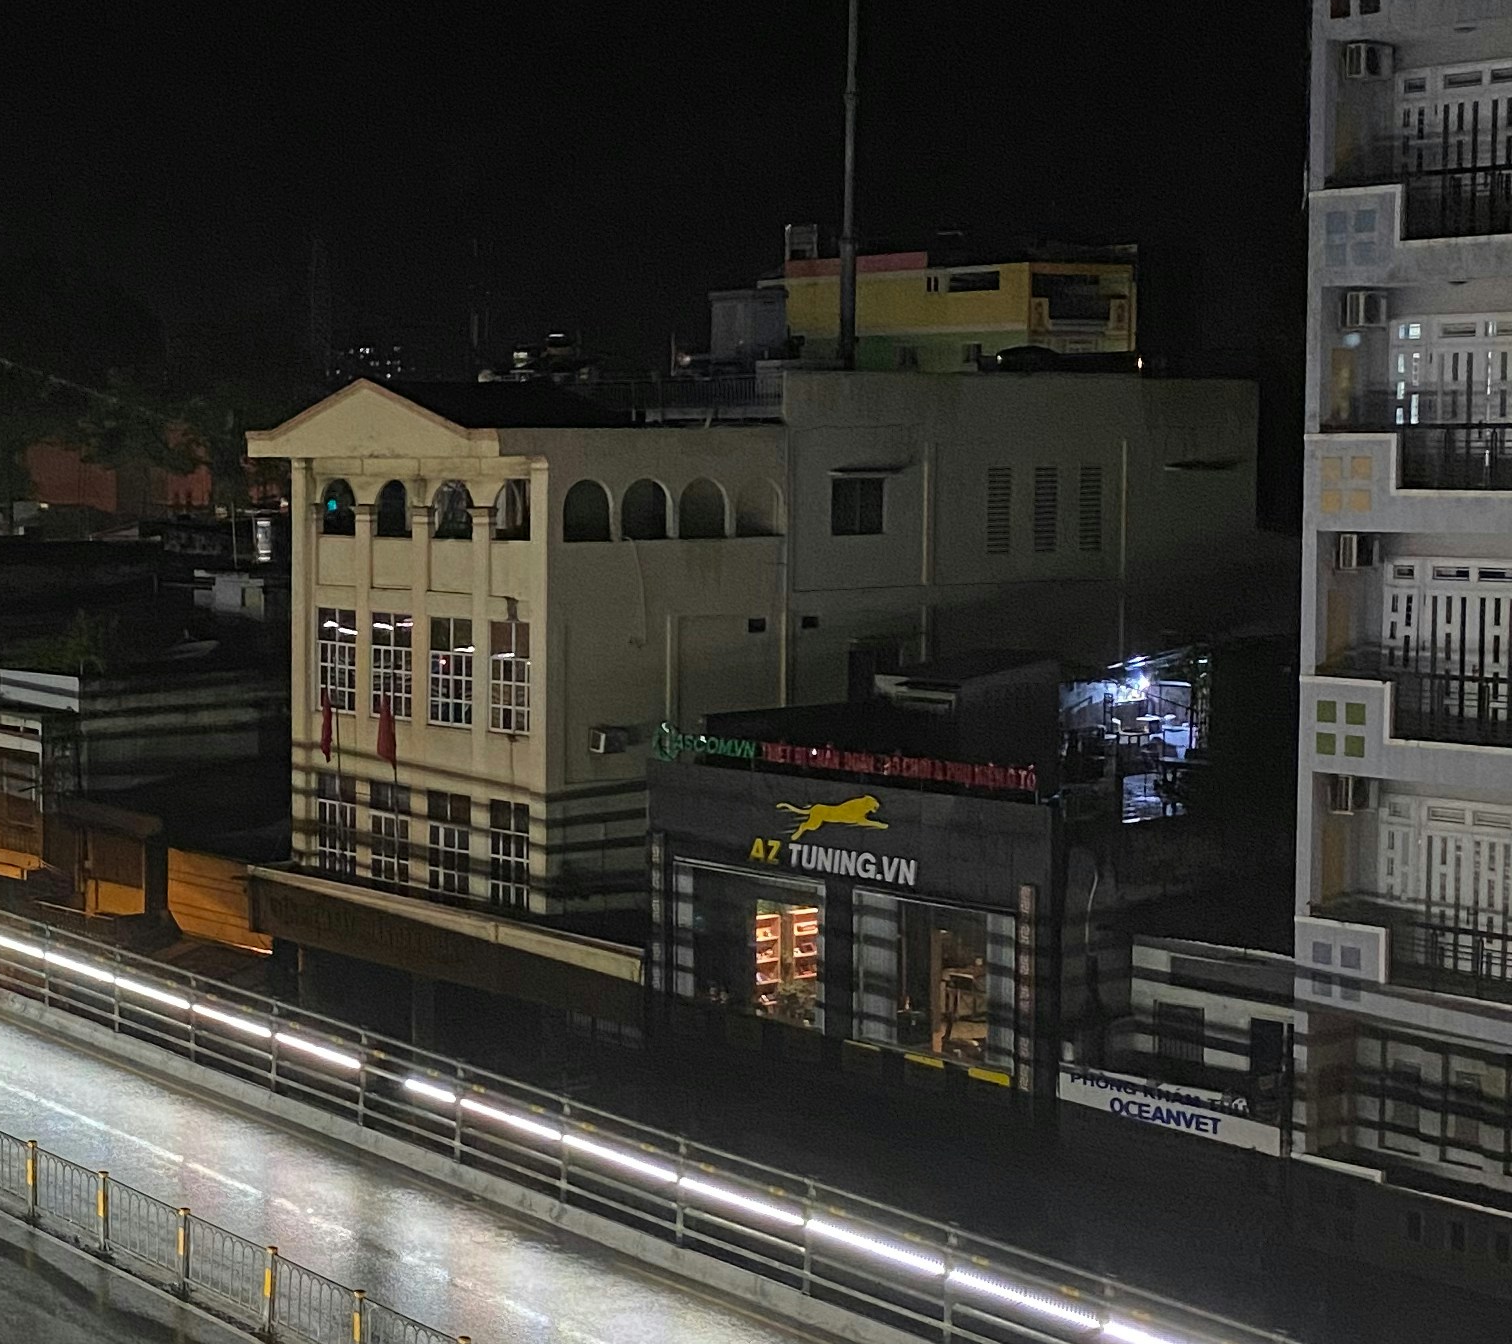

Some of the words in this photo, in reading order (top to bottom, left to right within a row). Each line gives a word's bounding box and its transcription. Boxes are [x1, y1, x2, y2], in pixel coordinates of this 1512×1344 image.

[750, 838, 781, 864] AZ
[789, 843, 917, 885] TUNING.VN
[1109, 1097, 1221, 1134] OCEANVET
